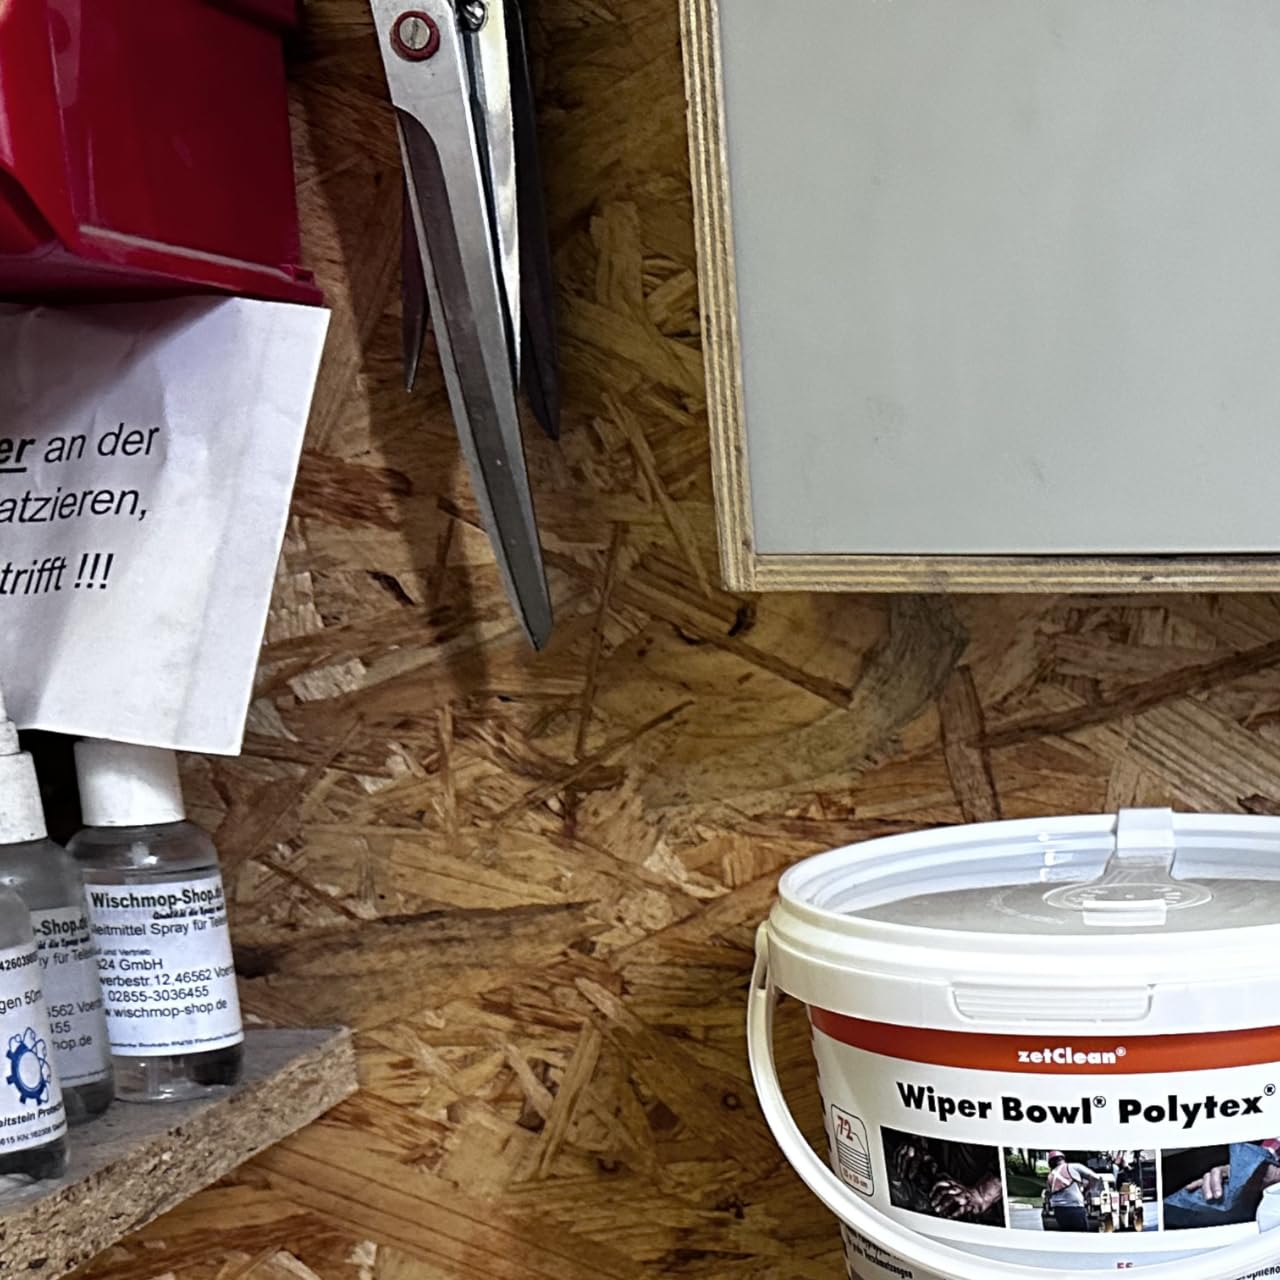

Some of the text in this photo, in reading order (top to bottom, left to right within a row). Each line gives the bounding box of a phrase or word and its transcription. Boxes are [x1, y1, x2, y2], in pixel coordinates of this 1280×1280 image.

[44, 434, 86, 463] an
[97, 422, 160, 457] der
[0, 553, 114, 595] trifft !!!
[150, 919, 207, 937] Spray für
[119, 959, 163, 971] GmbH
[108, 986, 210, 1002] 02855-3036455
[896, 1081, 992, 1122] Wiper
[837, 1115, 854, 1141] 72
